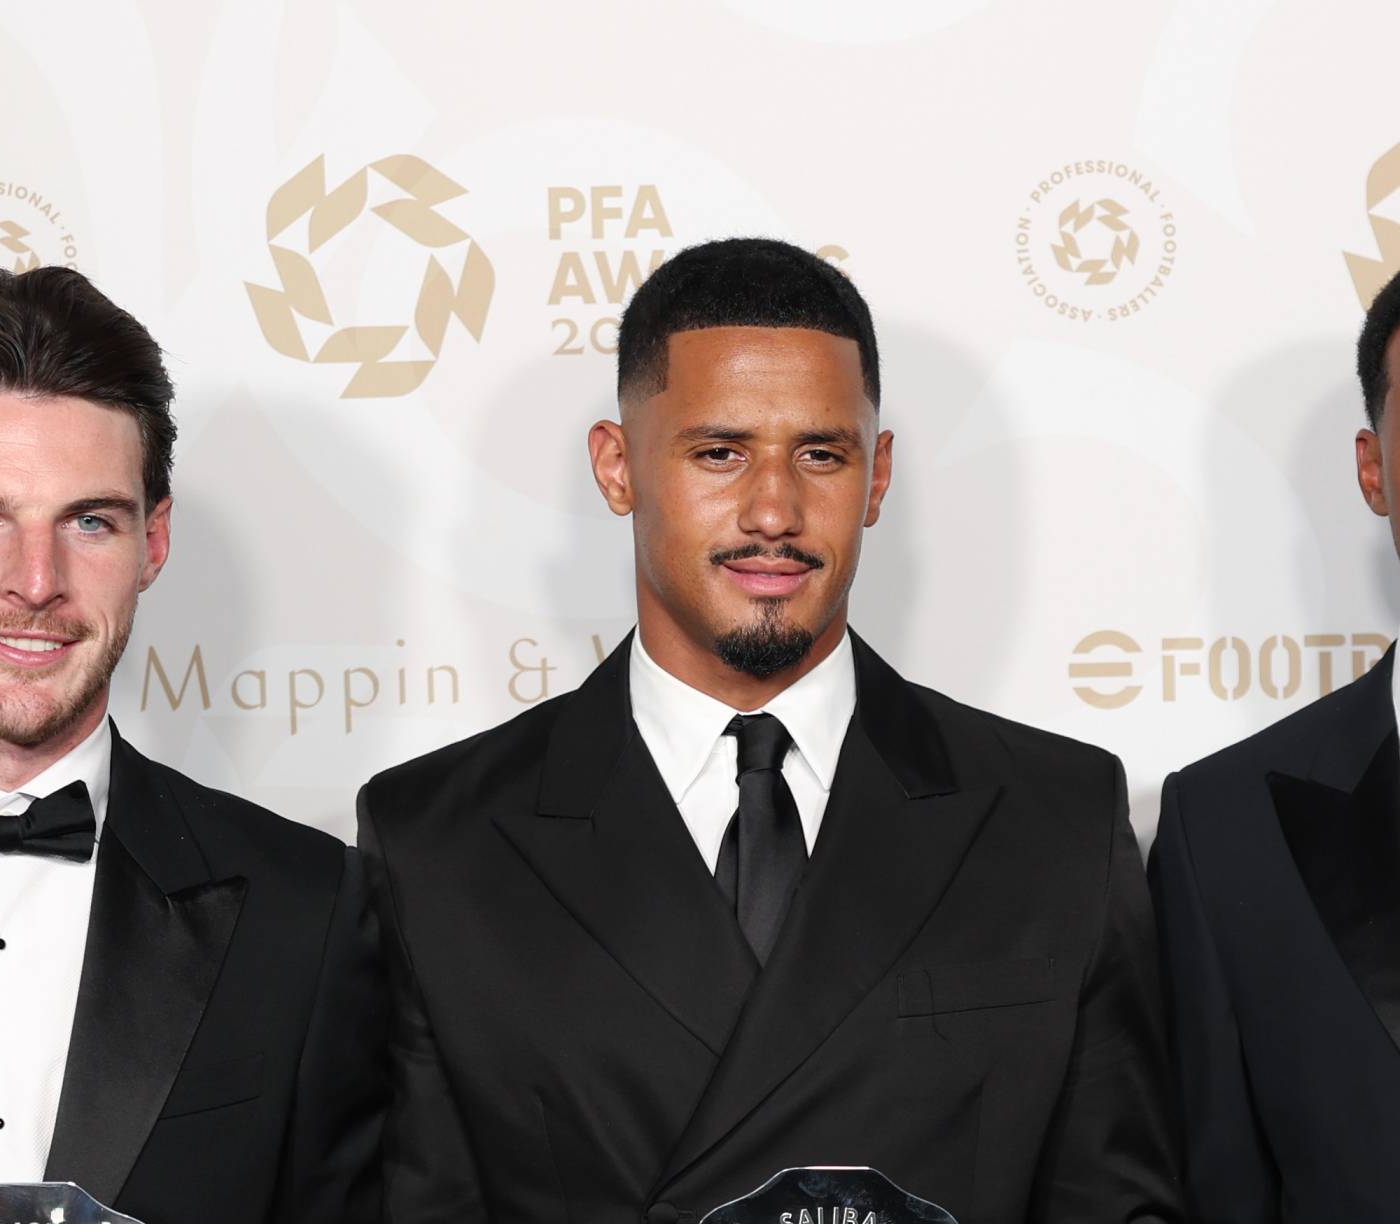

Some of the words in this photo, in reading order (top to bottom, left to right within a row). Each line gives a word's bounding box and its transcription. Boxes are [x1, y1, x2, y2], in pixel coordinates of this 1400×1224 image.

[547, 184, 674, 240] PFA
[1030, 160, 1160, 203] PROFESSIONAL
[1016, 217, 1093, 322] ASSOCIATION
[1108, 212, 1177, 321] FOOTBALLERS
[140, 638, 460, 736] Mappin
[507, 637, 558, 704] &
